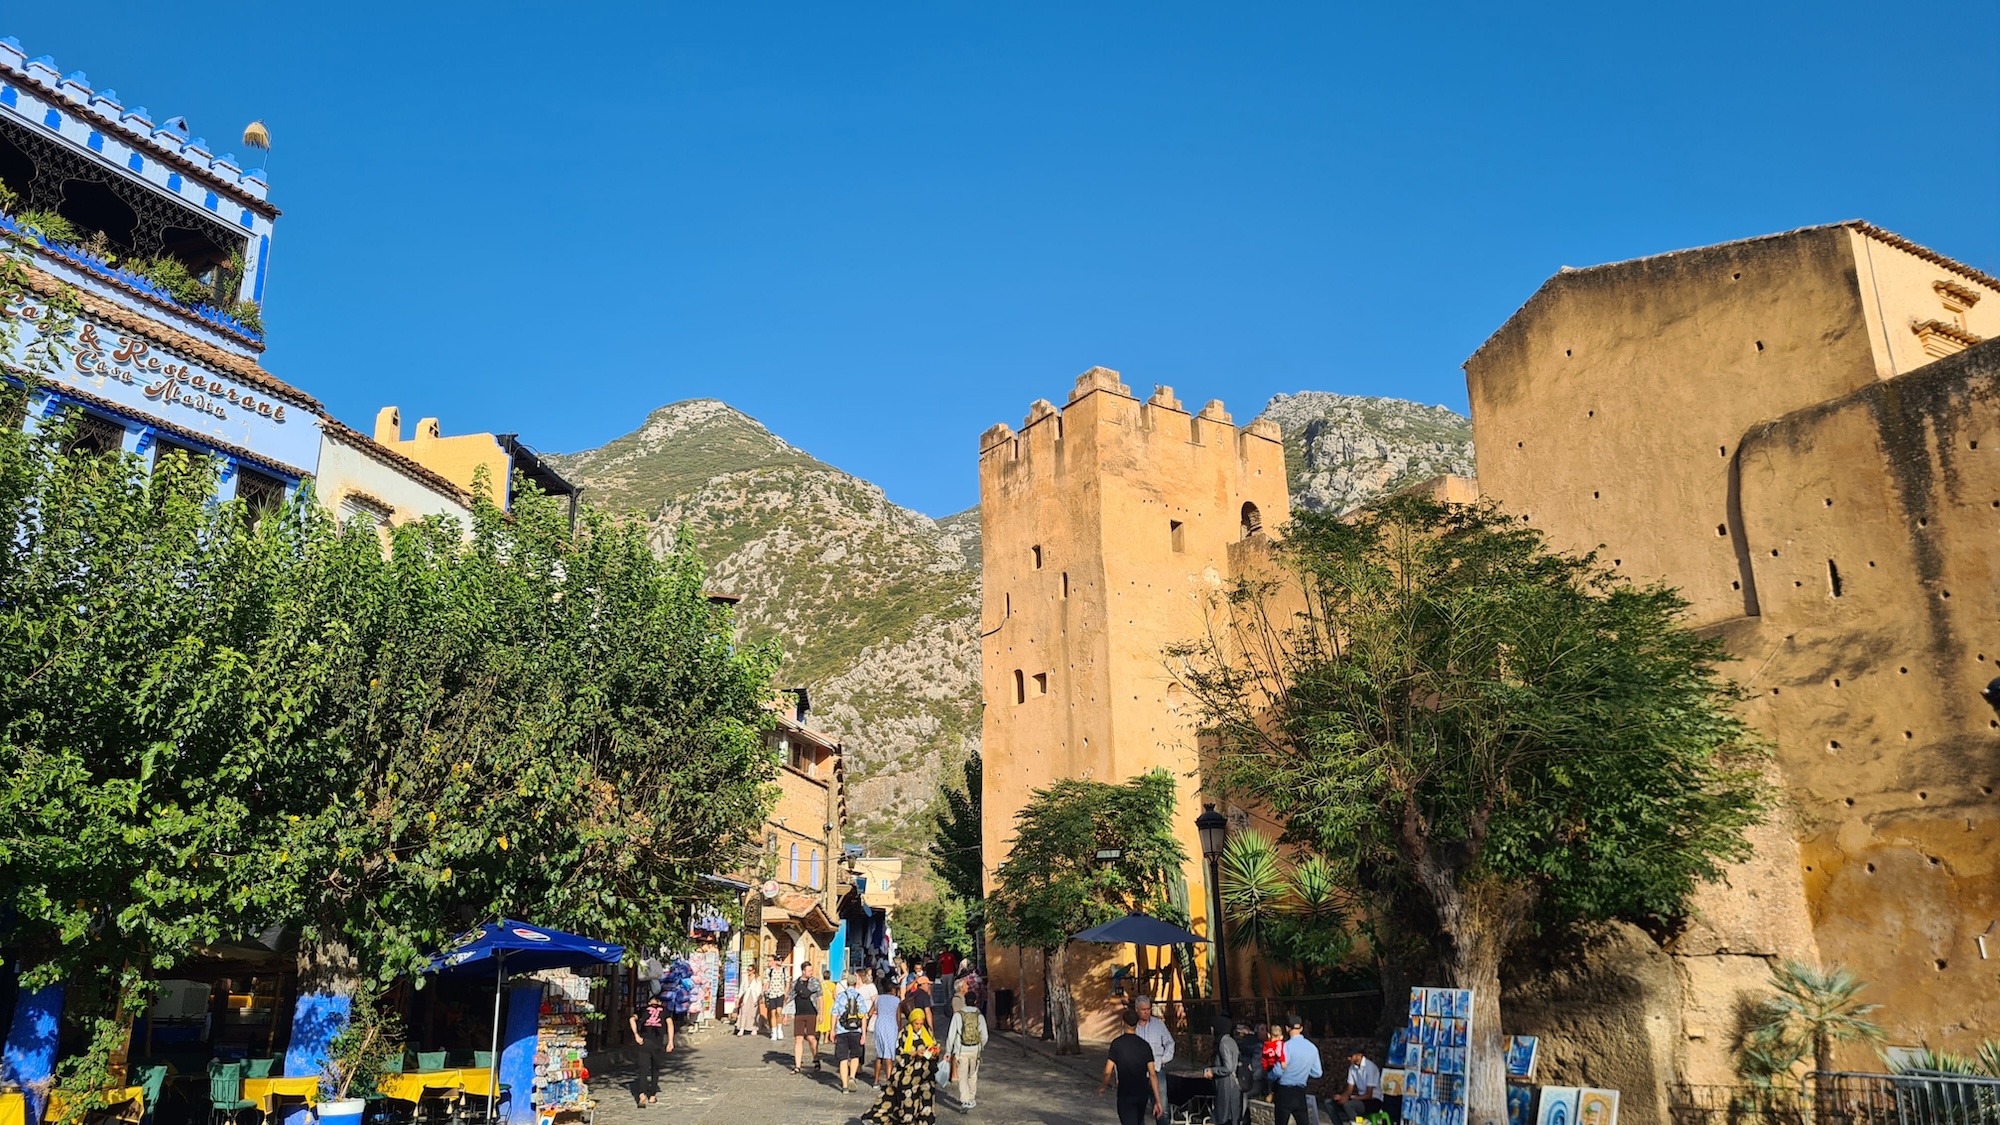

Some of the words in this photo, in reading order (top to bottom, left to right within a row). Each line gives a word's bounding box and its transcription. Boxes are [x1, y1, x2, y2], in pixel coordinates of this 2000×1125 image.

[71, 345, 132, 381] Casa
[144, 378, 226, 416] Aladin
[78, 323, 104, 352] &
[112, 337, 286, 420] Restaurant
